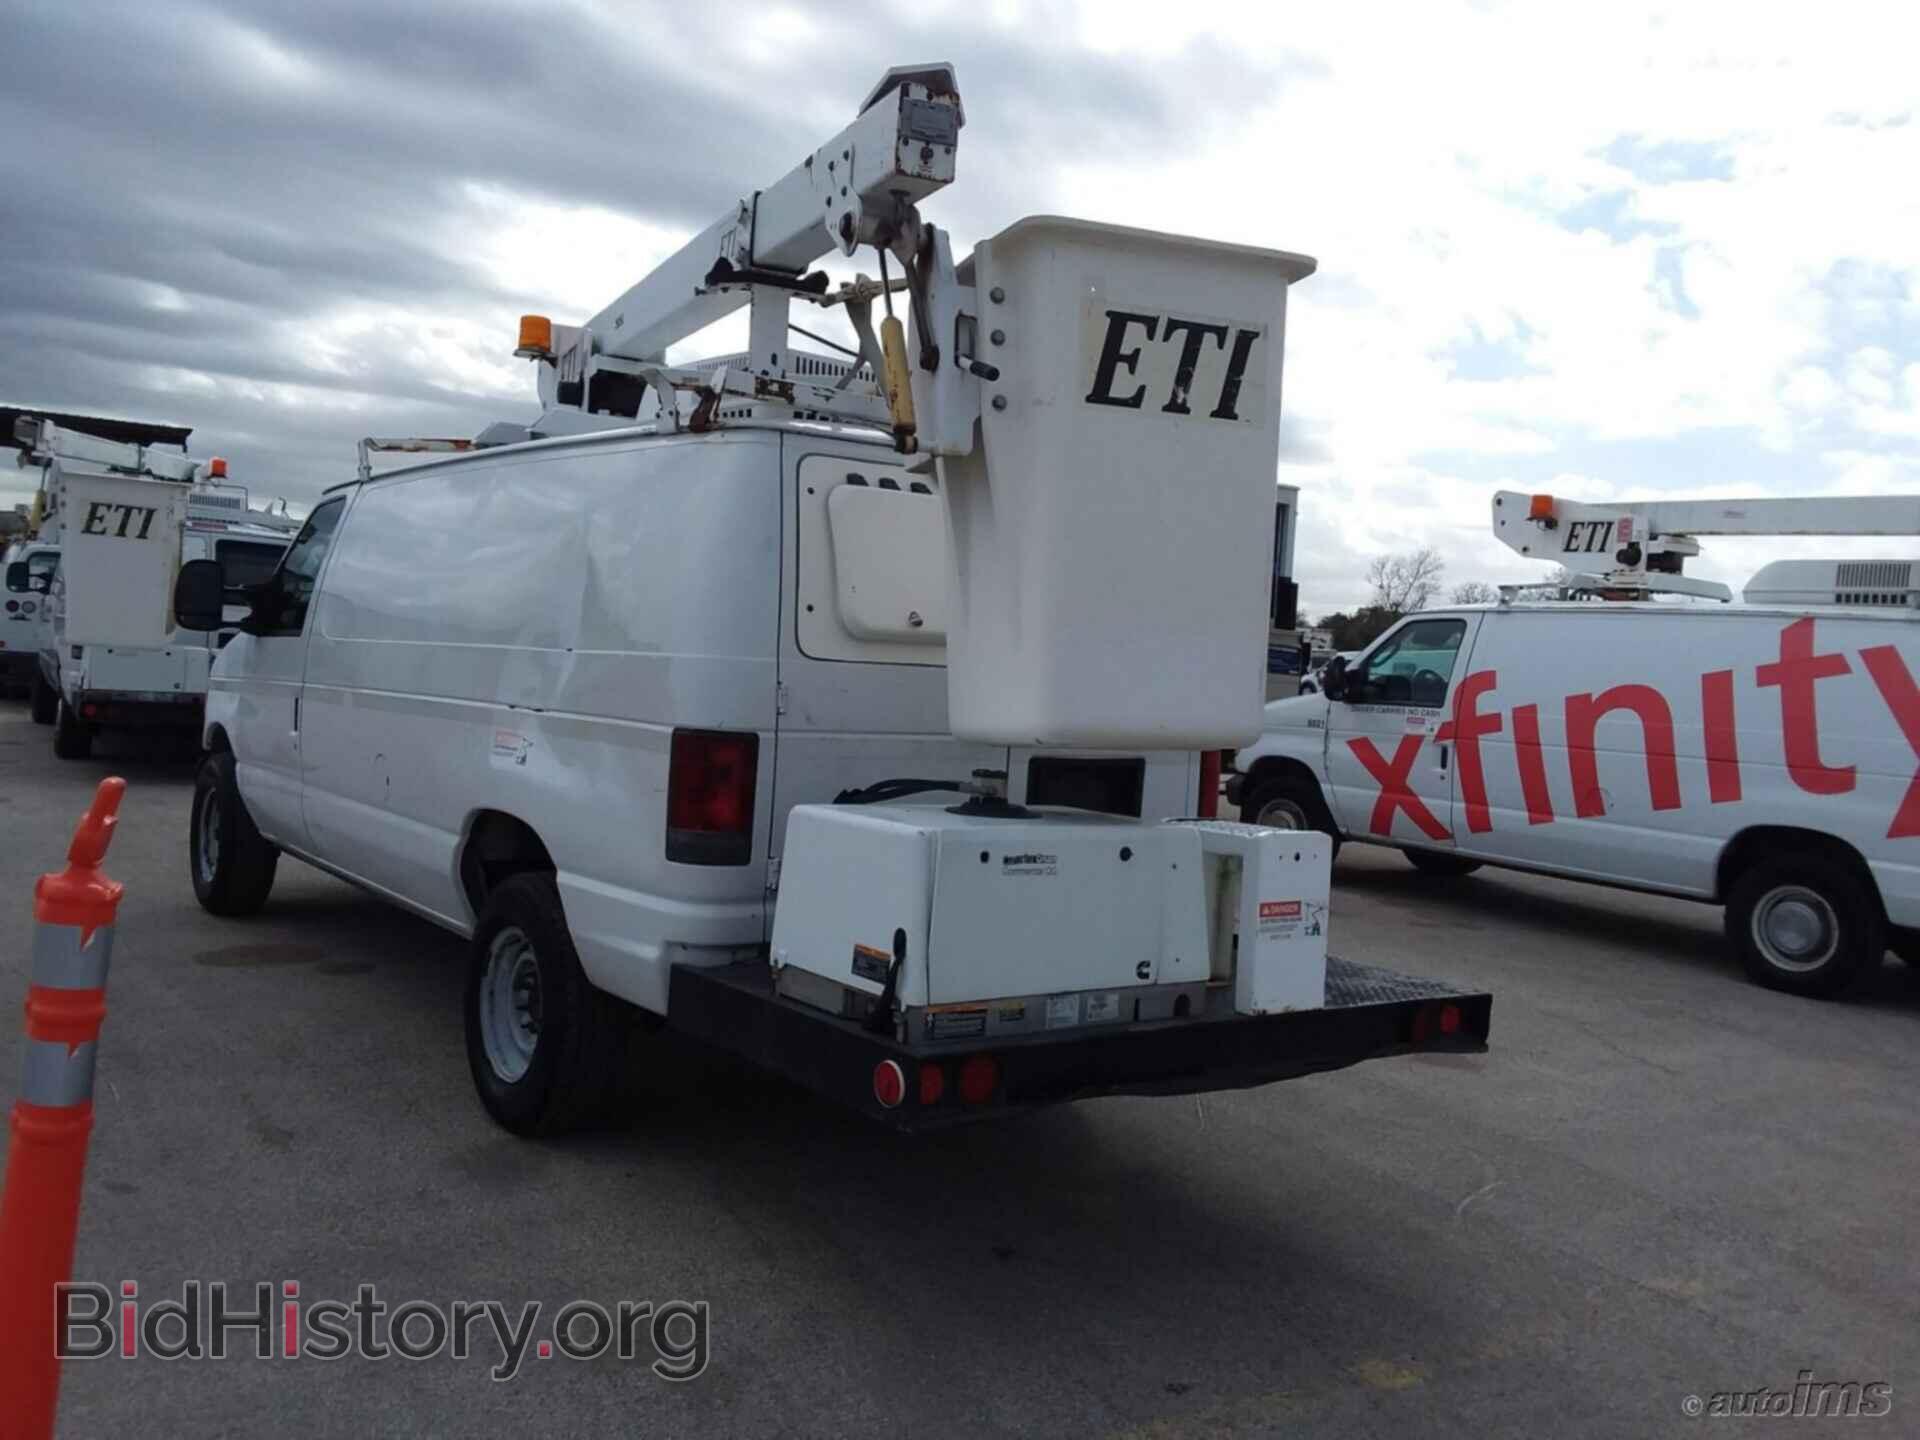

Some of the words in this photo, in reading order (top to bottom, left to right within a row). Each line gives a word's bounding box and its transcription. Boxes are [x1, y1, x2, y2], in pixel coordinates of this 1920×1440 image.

[1085, 310, 1260, 420] ETI
[81, 502, 158, 540] ETI
[1563, 521, 1615, 553] ETI
